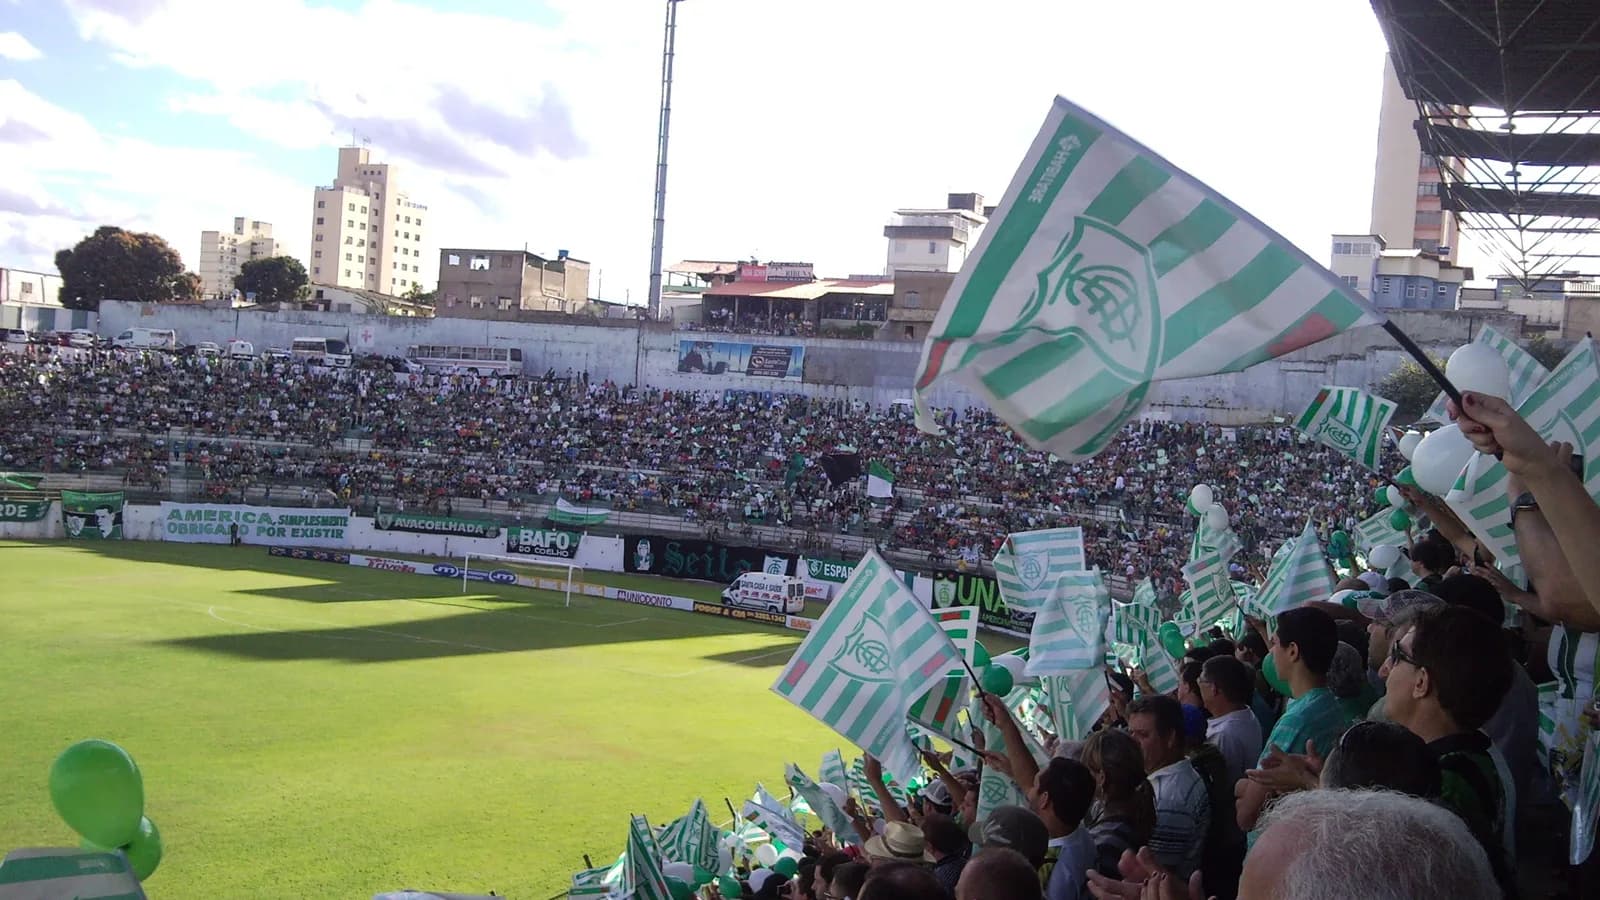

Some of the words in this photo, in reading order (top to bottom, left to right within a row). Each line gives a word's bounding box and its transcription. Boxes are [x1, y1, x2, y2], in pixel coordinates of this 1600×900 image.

[256, 526, 286, 537] POR
[291, 527, 344, 539] EXISTIR
[519, 529, 570, 550] BAFO
[534, 547, 569, 557] COELHO
